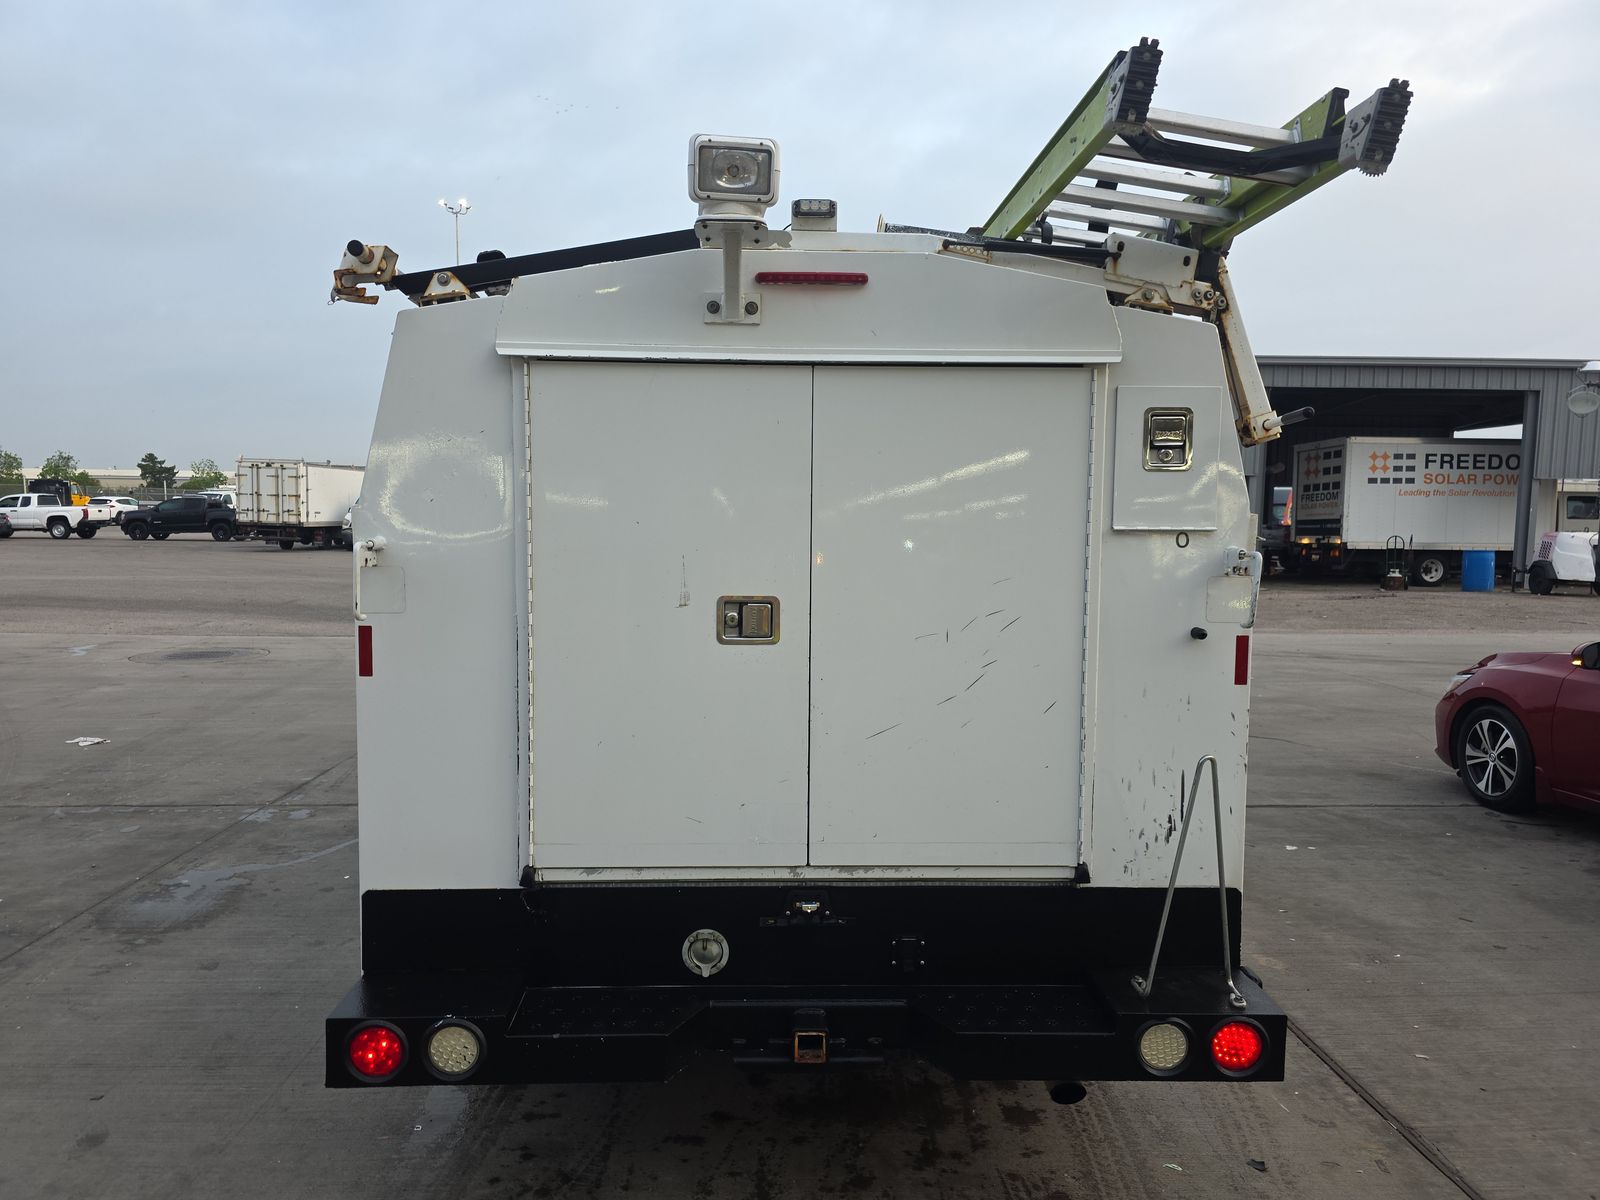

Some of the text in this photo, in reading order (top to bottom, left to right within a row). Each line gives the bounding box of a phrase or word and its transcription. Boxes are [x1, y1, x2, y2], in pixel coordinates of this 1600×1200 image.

[1425, 453, 1520, 470] FREEDO
[1424, 473, 1477, 485] SOLAR
[1301, 491, 1339, 503] FREEDOM
[1397, 488, 1515, 497] Leading the Solar Revolution
